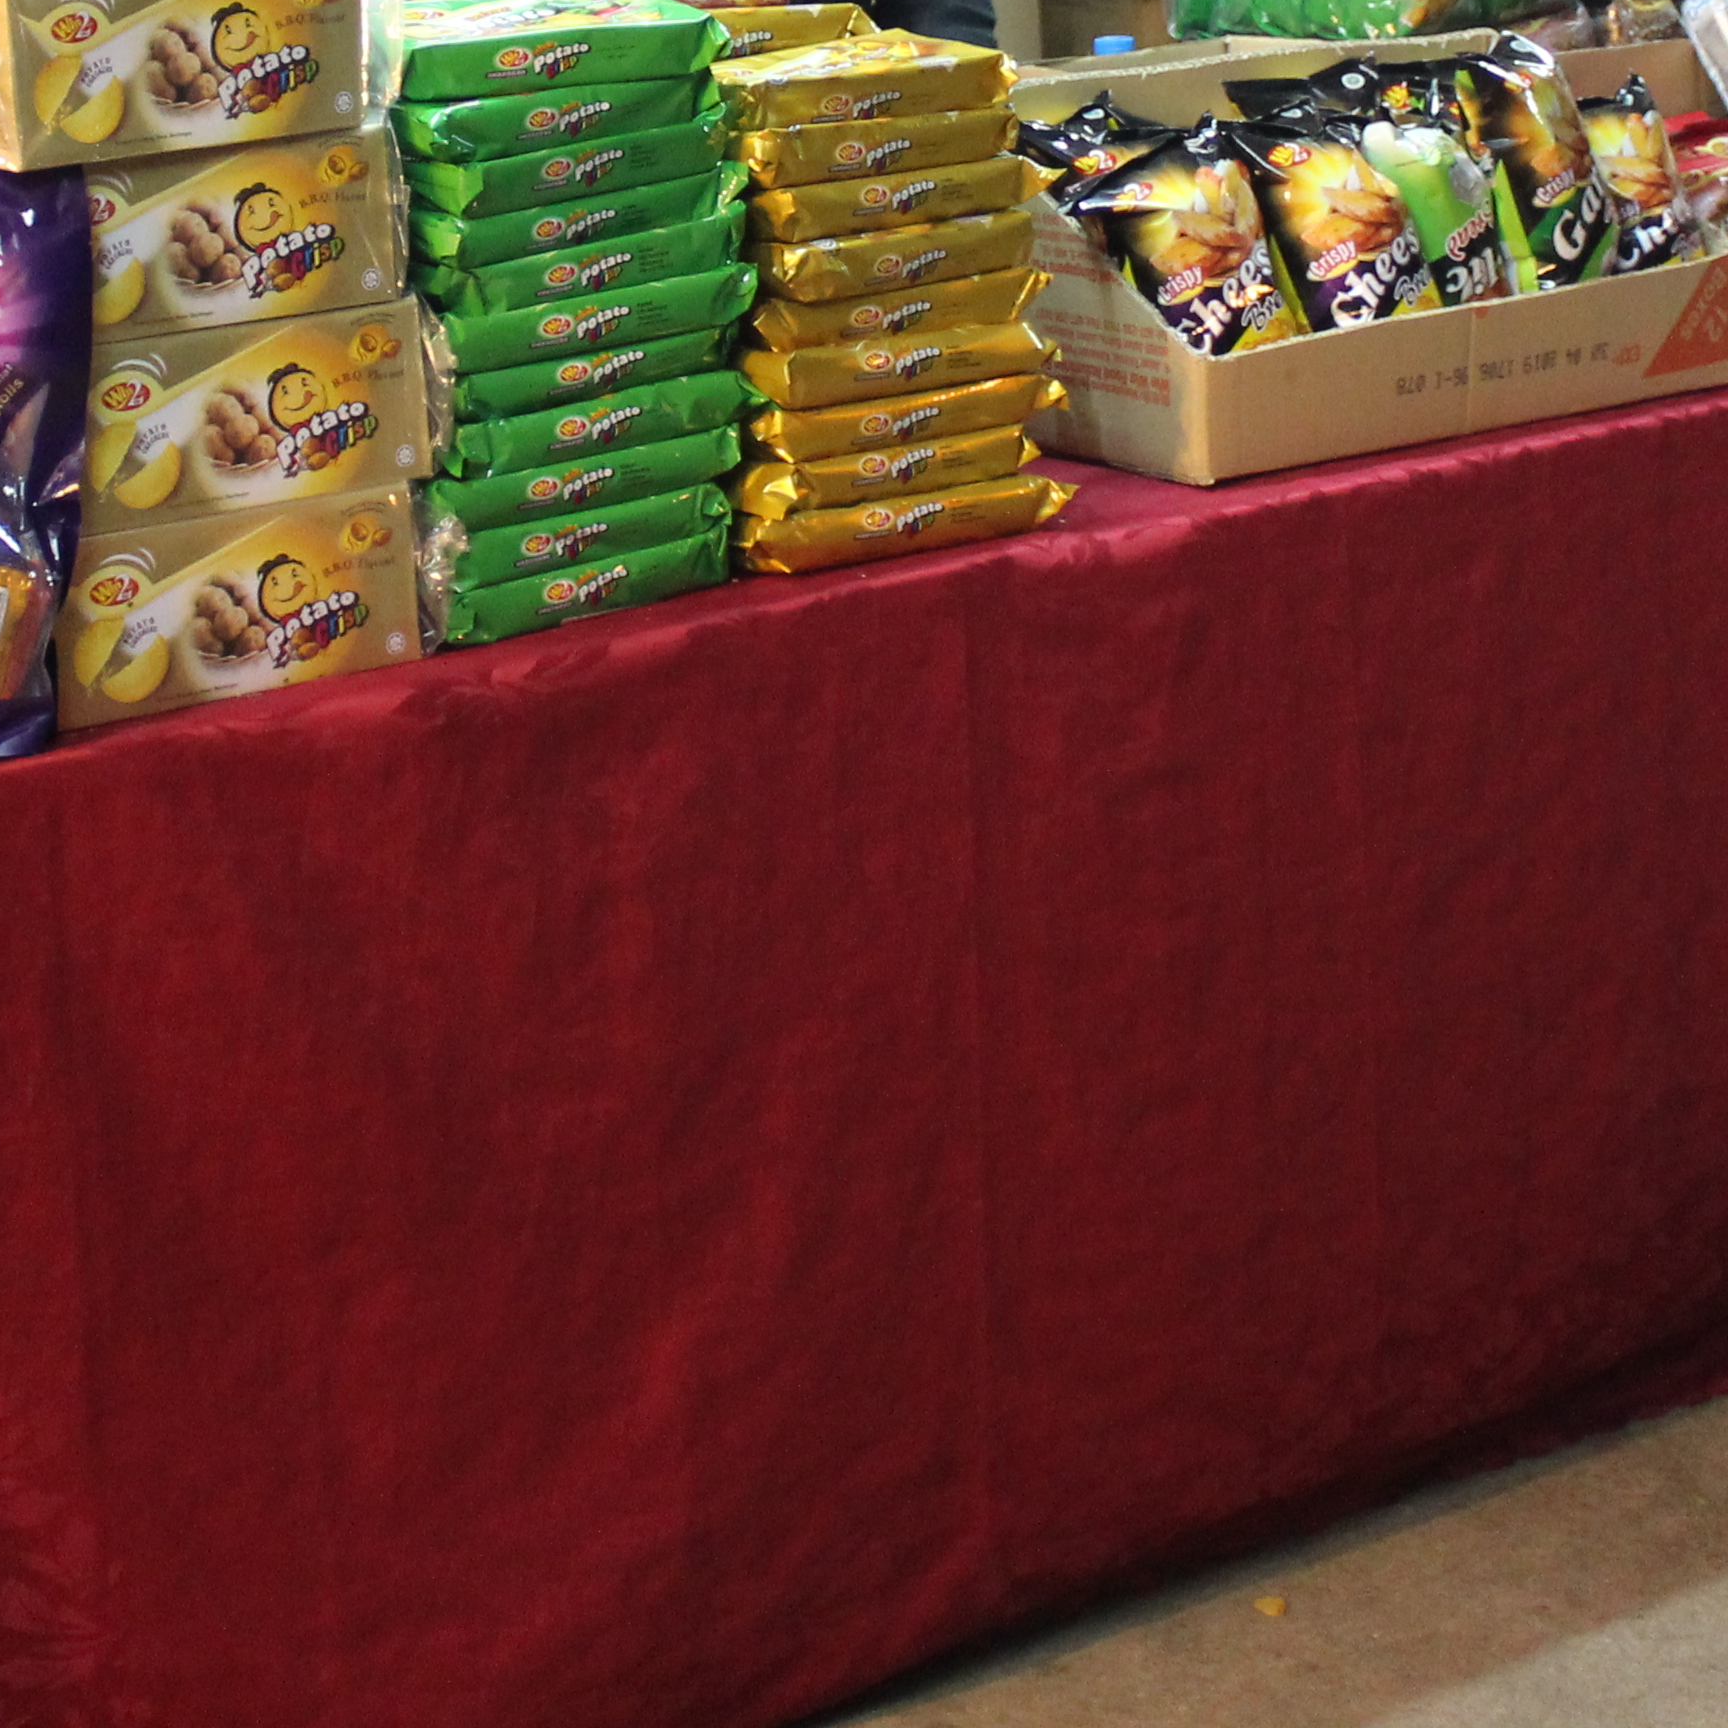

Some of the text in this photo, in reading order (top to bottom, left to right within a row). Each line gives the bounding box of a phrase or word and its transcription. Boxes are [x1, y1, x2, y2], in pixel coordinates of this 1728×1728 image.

[216, 42, 309, 109] potato
[533, 41, 590, 74] potato
[559, 100, 612, 132] potato
[574, 148, 624, 182] potato
[241, 220, 334, 291] potato
[580, 252, 633, 287] potato
[1307, 239, 1358, 281] Crispy
[1157, 264, 1204, 303] Crispy
[575, 304, 631, 341] potato
[593, 349, 645, 384] potato
[277, 400, 369, 470] potato
[590, 405, 642, 441] potato
[562, 467, 614, 502] potato
[554, 522, 609, 557] potato
[578, 565, 629, 605] potato
[265, 589, 359, 659] potato
